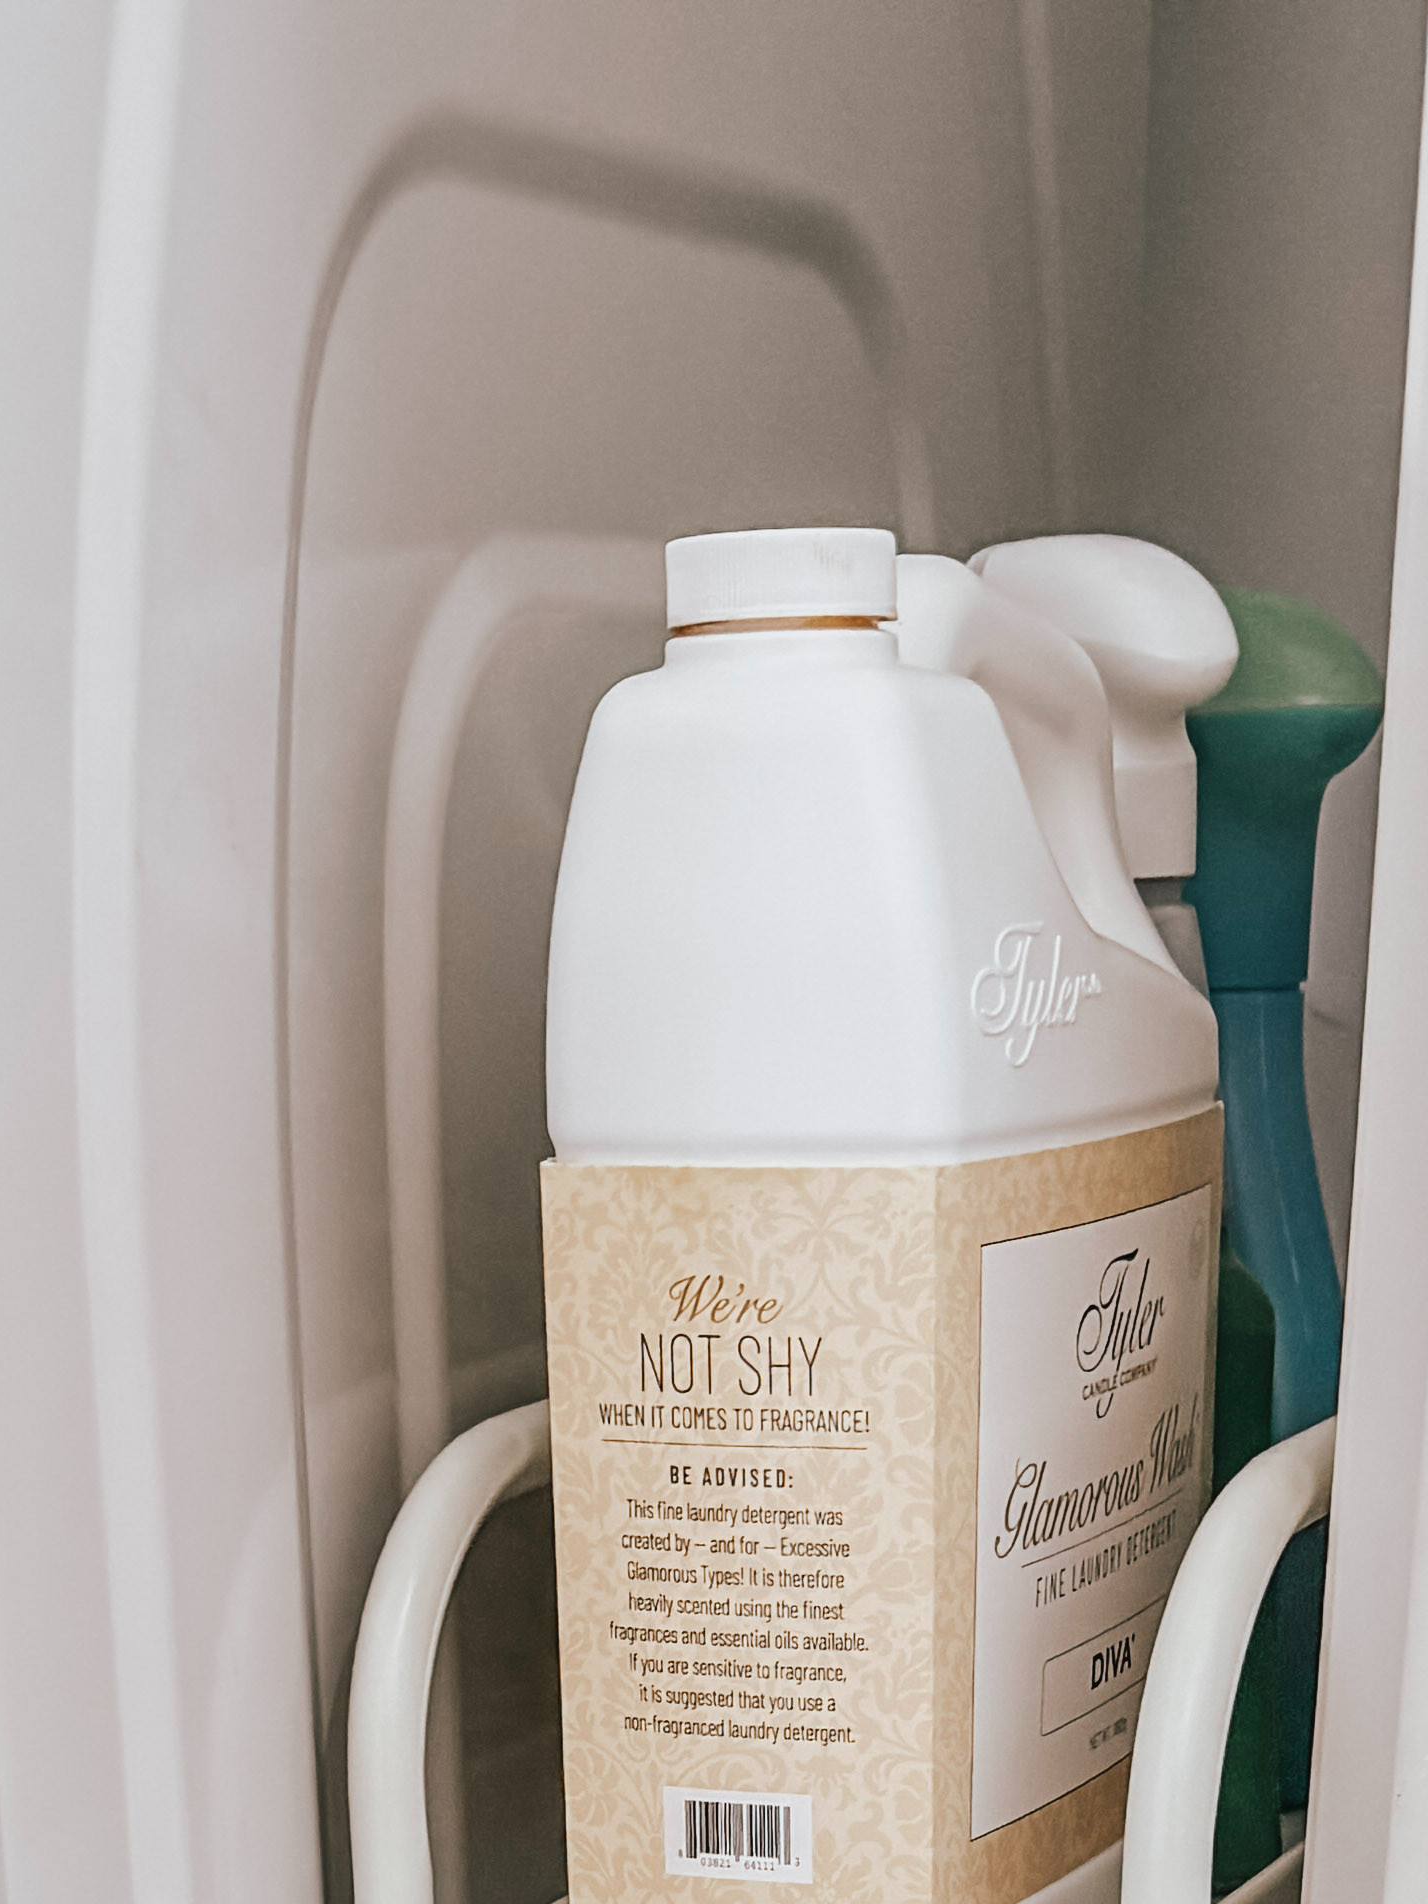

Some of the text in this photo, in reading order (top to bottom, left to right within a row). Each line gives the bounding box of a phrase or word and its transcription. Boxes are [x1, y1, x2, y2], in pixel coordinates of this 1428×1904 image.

[971, 920, 1086, 1068] Tyler
[668, 1274, 784, 1325] We're
[1076, 1247, 1165, 1419] Tyler
[640, 1332, 822, 1397] NOT SHY
[598, 1402, 870, 1434] WHEN IT COMES TO FRAGRANCE!
[669, 1465, 794, 1489] BE ADVISED:
[626, 1498, 843, 1529] This fine laundry detergent was
[994, 1456, 1144, 1559] Glamorous
[621, 1533, 671, 1551] created
[674, 1533, 692, 1556] by
[709, 1536, 735, 1555] and
[739, 1536, 760, 1555] for
[780, 1536, 851, 1558] Excessive
[627, 1560, 845, 1589] Glamorous Types! It is therefore
[1035, 1567, 1066, 1608] FINE
[1072, 1540, 1123, 1593] LAUNDRY
[628, 1591, 845, 1623] heavily scented using the finest
[609, 1620, 869, 1651] fragrances and essential oils available.
[629, 1652, 847, 1686] If you are sensitive to fragrance,
[1090, 1636, 1132, 1690] DIVA
[638, 1683, 836, 1714] it is suggested that you use a
[624, 1714, 856, 1746] non-fragranced laundry detergent.
